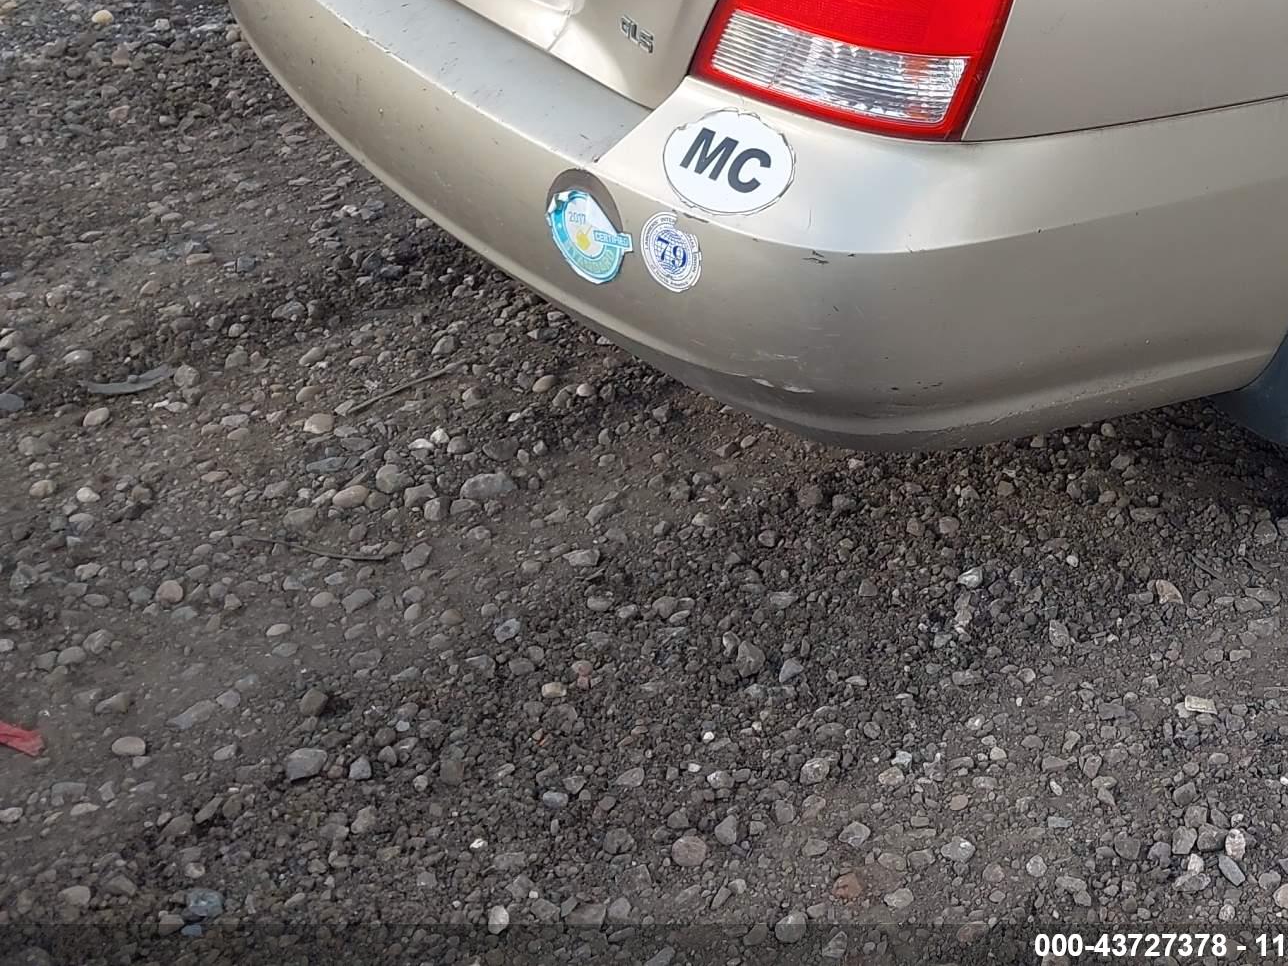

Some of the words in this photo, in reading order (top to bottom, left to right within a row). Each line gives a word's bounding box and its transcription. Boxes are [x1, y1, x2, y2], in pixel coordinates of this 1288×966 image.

[620, 12, 654, 53] GLS
[679, 127, 772, 194] MC
[656, 236, 687, 269] 79
